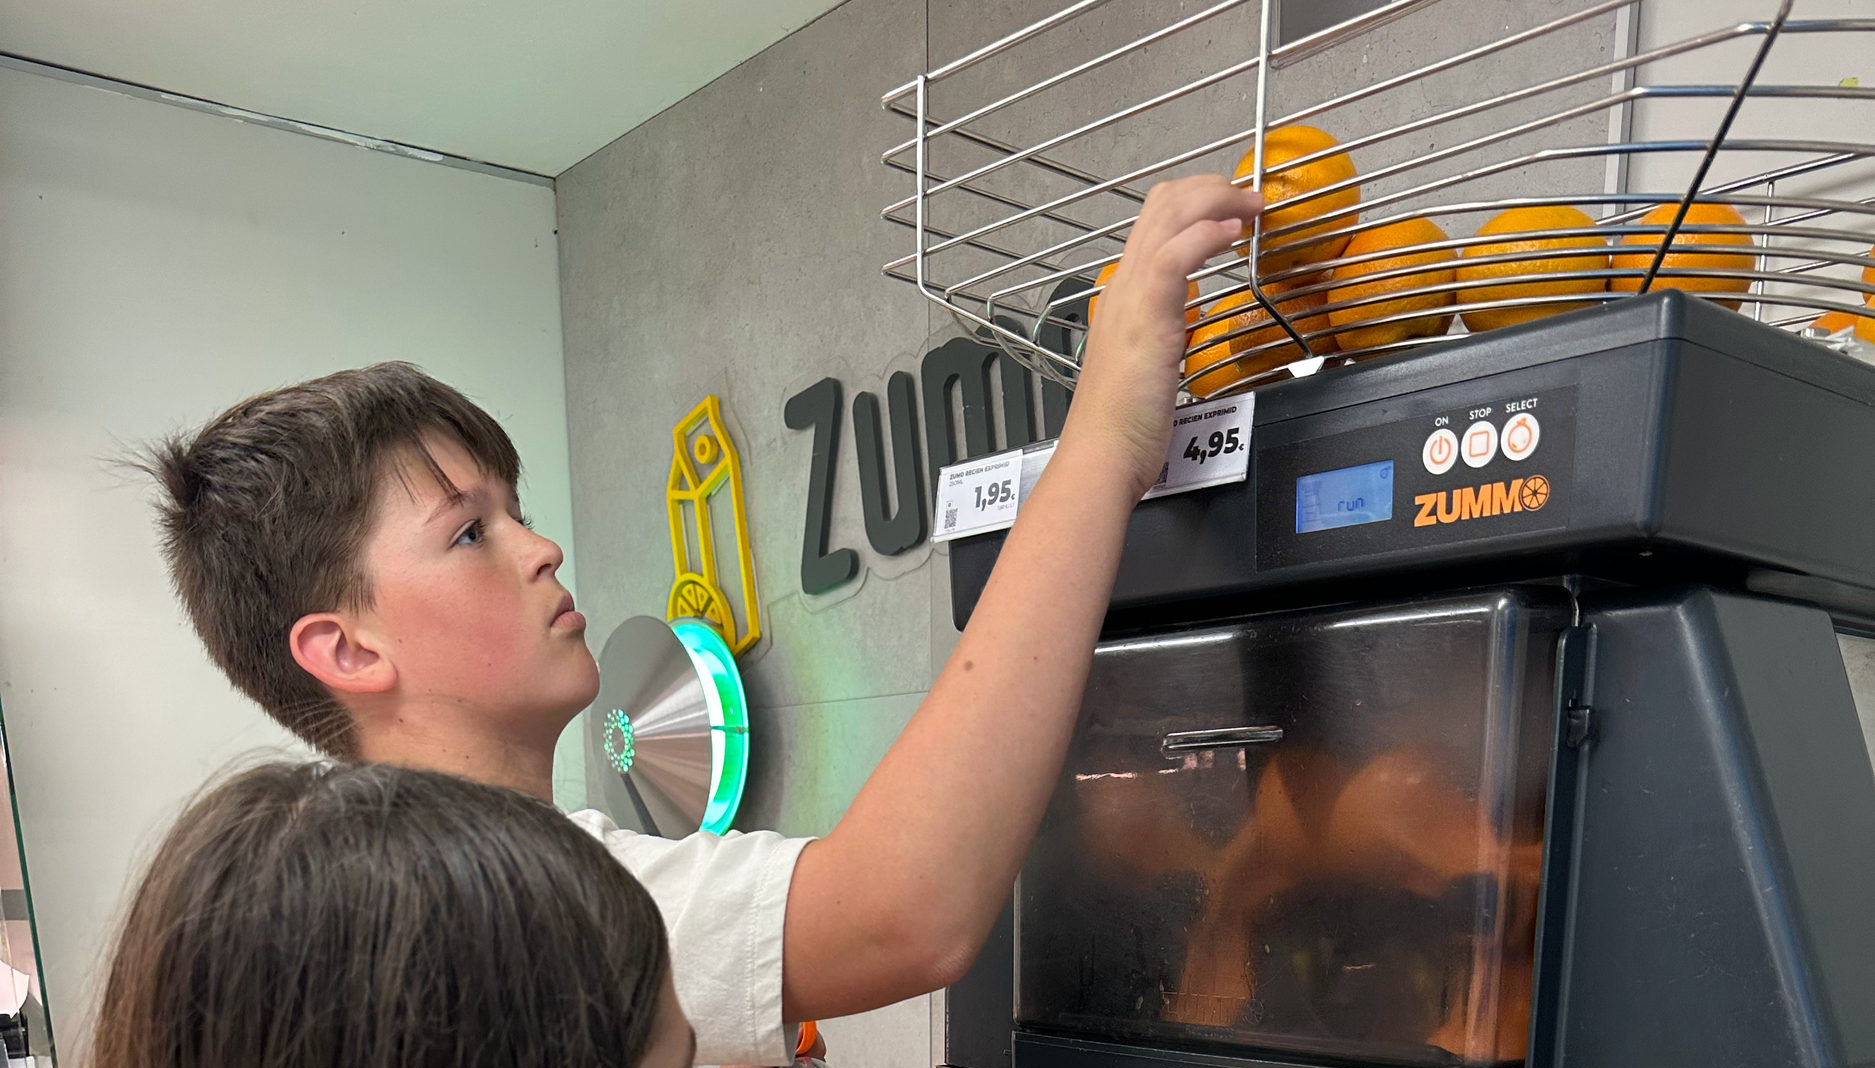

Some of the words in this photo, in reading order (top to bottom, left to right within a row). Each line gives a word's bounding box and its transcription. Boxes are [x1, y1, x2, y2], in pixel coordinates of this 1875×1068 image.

[1506, 398, 1538, 413] SELECT
[1179, 413, 1203, 425] RECIEN
[1204, 406, 1237, 420] EXPRIMID
[1435, 416, 1449, 426] ON
[1469, 407, 1492, 420] STOP
[949, 471, 965, 480] ZUMO
[1337, 497, 1365, 512] run
[1413, 474, 1551, 527] ZUMMO
